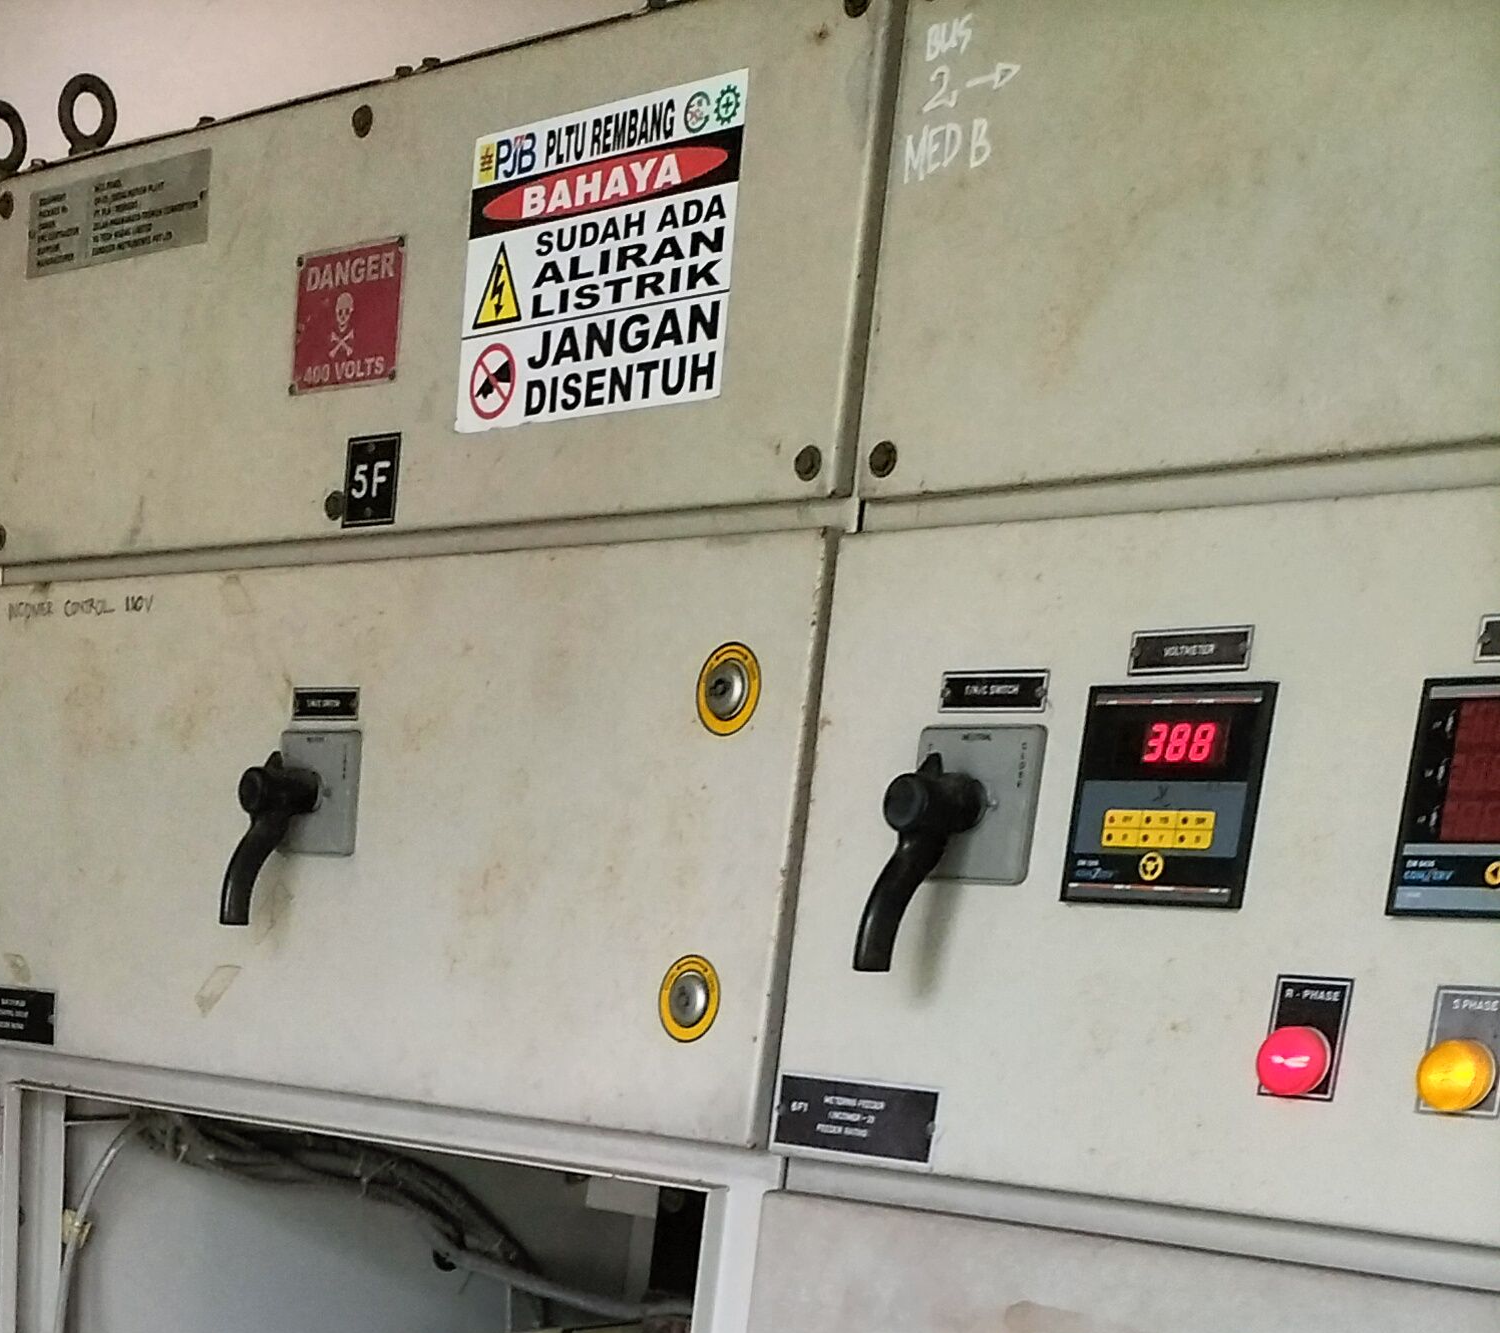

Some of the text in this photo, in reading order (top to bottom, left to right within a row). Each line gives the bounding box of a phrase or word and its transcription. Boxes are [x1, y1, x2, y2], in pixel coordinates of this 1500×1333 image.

[925, 13, 973, 62] BUS
[922, 64, 958, 113] 2
[494, 98, 675, 181] PJB PLTU REMBANG
[903, 118, 992, 184] MED B
[521, 154, 682, 218] BAHAYA
[536, 193, 726, 257] SUDAH ADA
[306, 251, 396, 291] DANGER
[532, 226, 725, 289] ALIRAN
[531, 258, 722, 319] LISTRIK
[526, 300, 720, 370] JANGAN
[303, 356, 385, 385] 400 VOLTS
[523, 351, 717, 416] DISENTUH
[350, 460, 391, 499] 5F
[1141, 722, 1217, 762] 388
[1302, 989, 1342, 1002] PHASE
[1463, 999, 1500, 1012] PHASE
